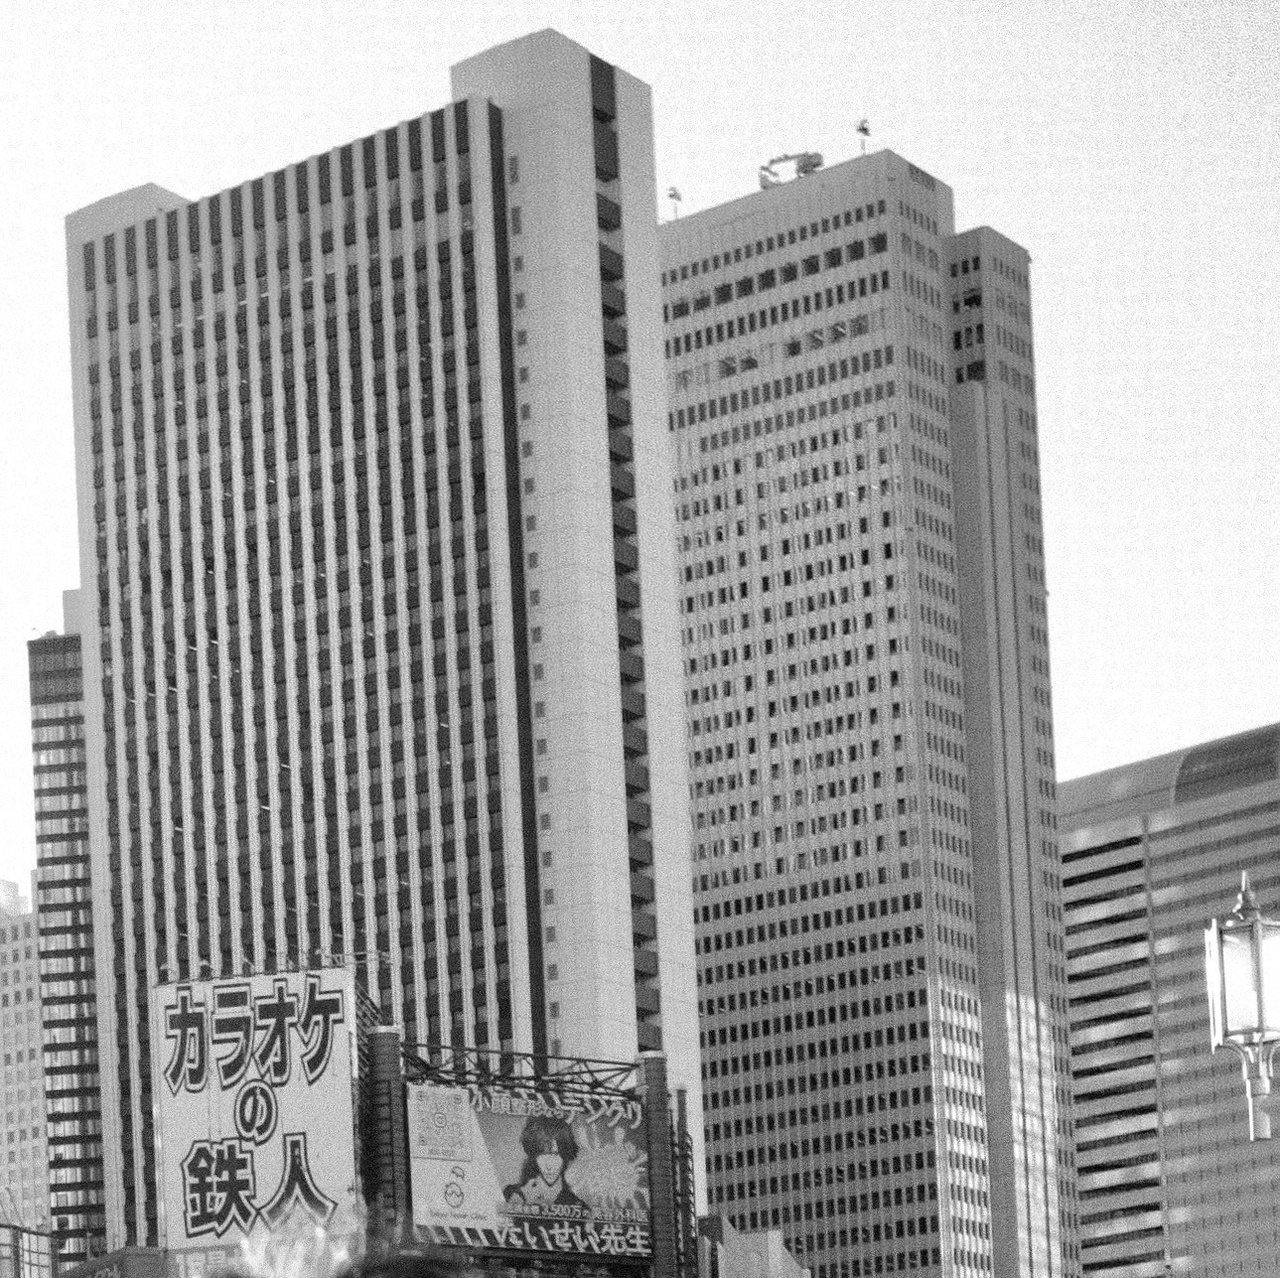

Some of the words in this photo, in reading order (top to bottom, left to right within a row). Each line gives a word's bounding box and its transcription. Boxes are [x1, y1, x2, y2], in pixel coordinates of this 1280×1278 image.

[164, 975, 344, 1094] カラオケ
[235, 1078, 277, 1143] の
[181, 1132, 337, 1238] 鉄人
